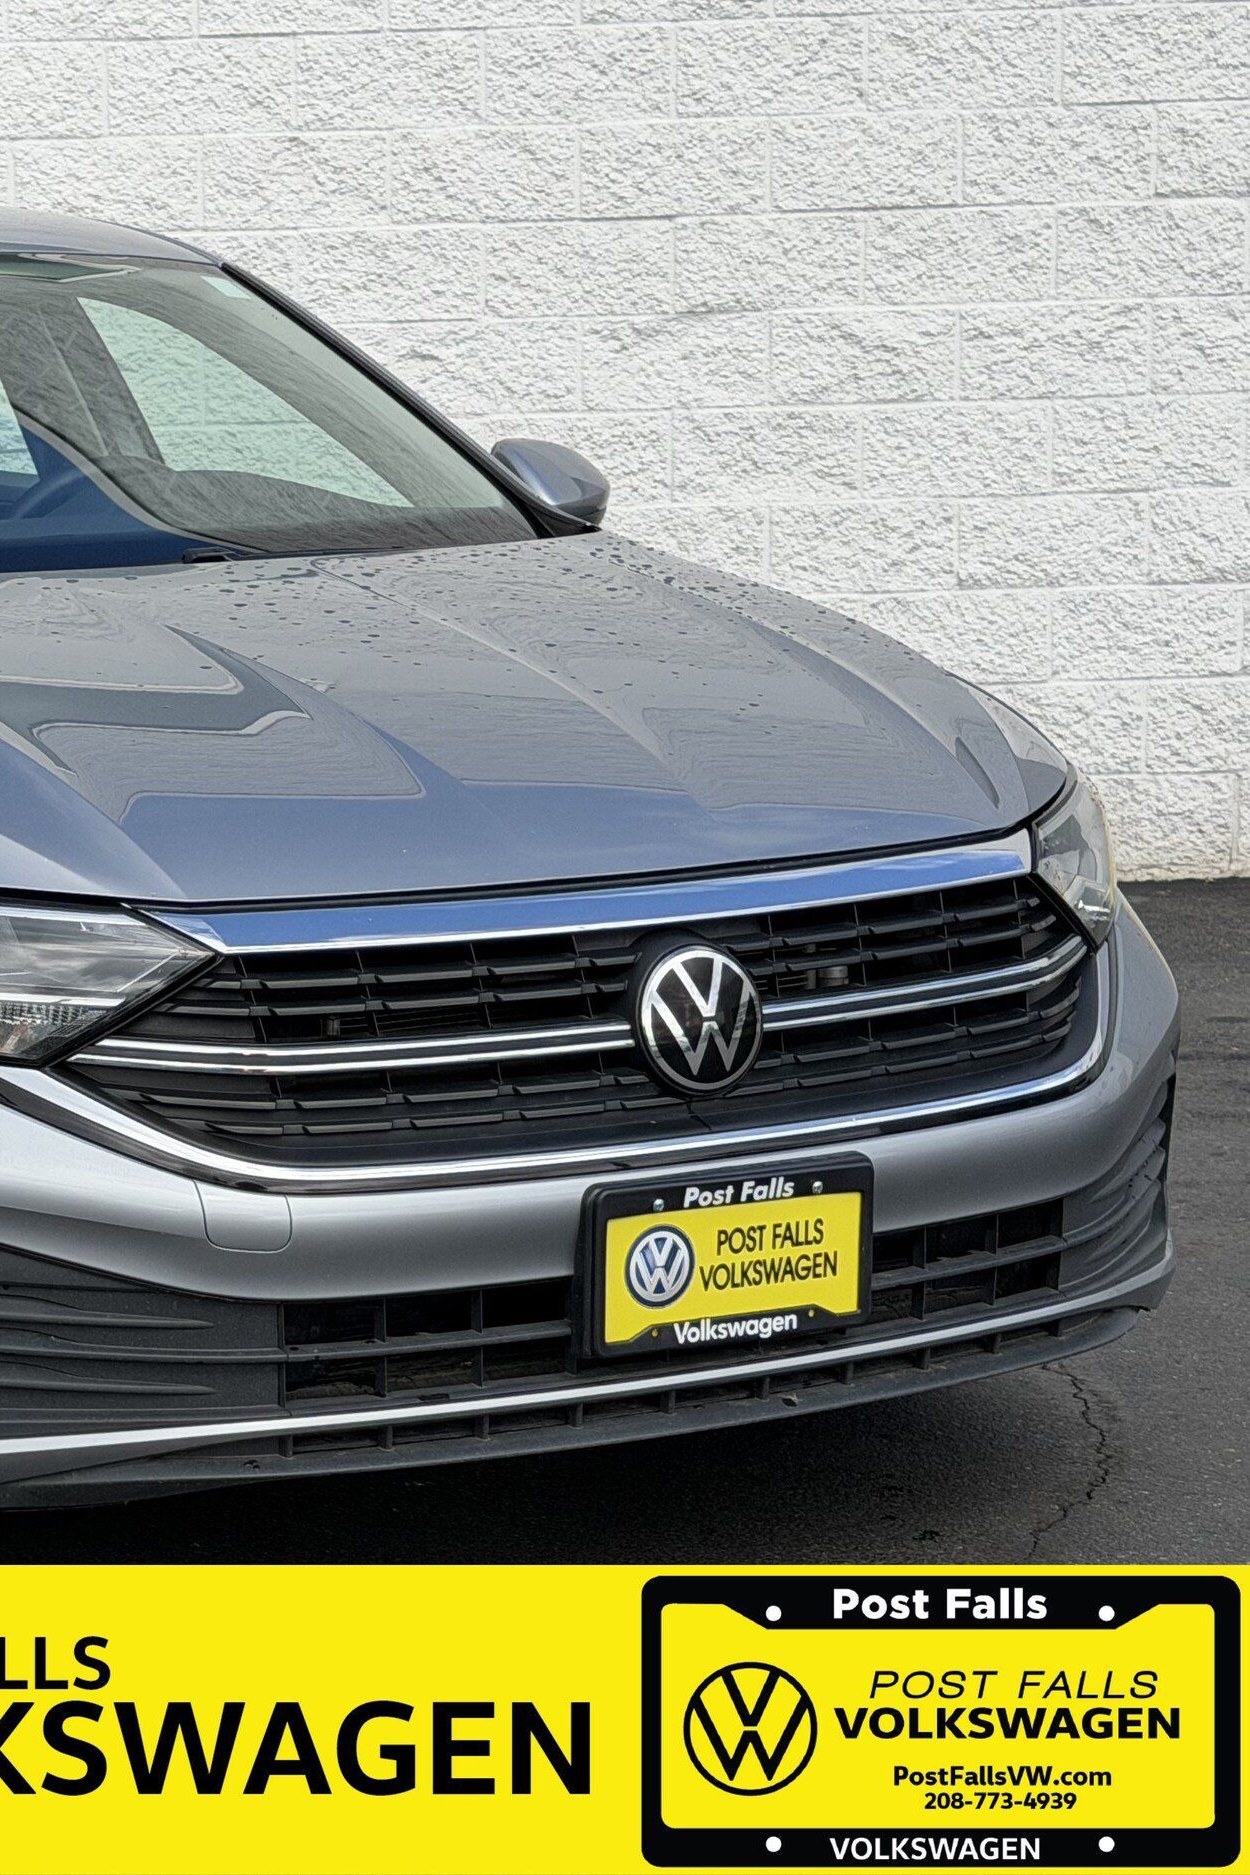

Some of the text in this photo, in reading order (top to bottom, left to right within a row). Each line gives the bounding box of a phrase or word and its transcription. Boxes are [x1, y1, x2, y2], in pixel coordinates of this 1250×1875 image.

[683, 1176, 795, 1208] Post Falls
[717, 1218, 824, 1256] POST FALLS
[699, 1250, 838, 1292] VOLKSWAGEN
[673, 1313, 798, 1345] Volkswagen
